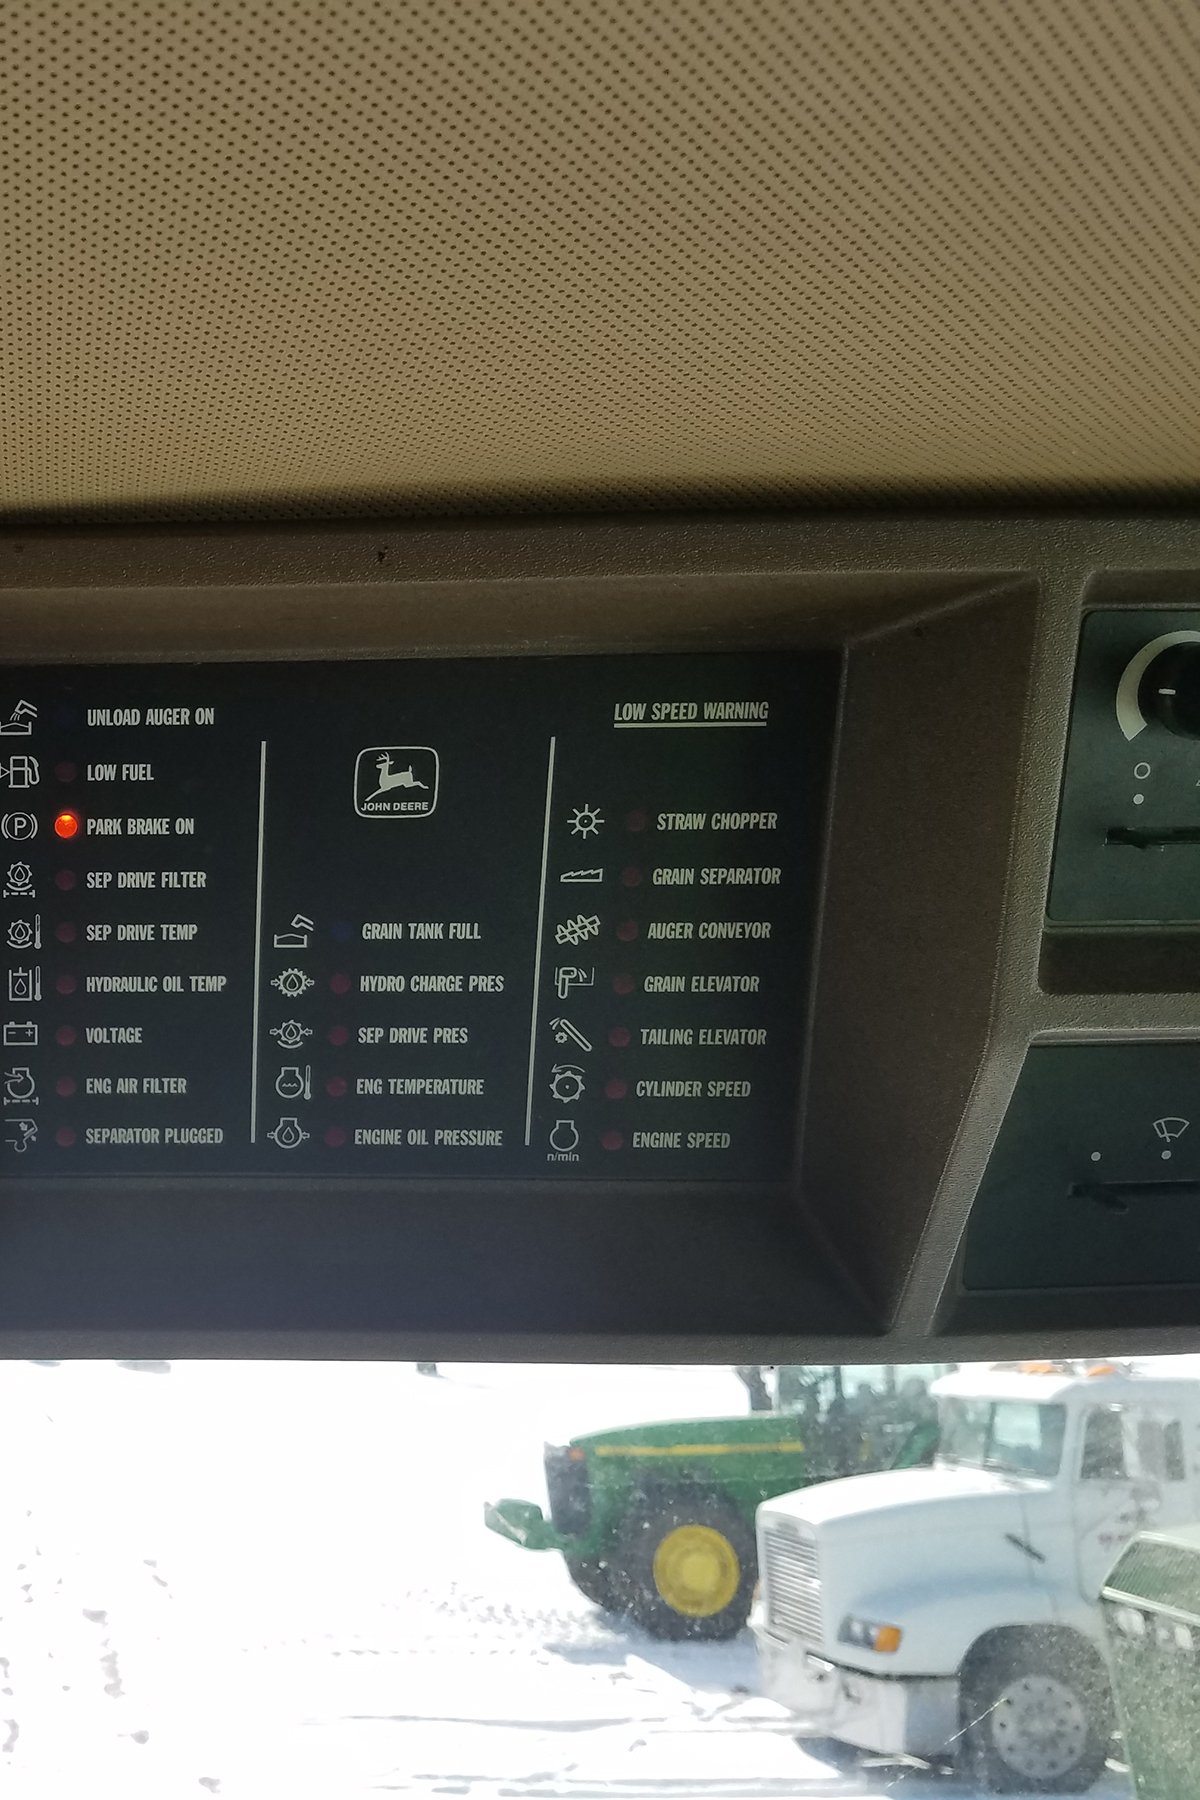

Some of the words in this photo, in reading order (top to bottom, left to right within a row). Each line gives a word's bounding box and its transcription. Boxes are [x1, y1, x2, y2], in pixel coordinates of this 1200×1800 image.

[87, 708, 141, 727] UNLOAD
[145, 707, 191, 726] AUGER
[194, 707, 215, 726] ON
[613, 703, 647, 722] LOW
[650, 702, 699, 721] SPEED
[702, 701, 770, 721] WARNING
[87, 763, 117, 782] LOW
[122, 763, 155, 781] FUEL
[360, 802, 391, 813] JOHN
[392, 801, 430, 812] DEERE
[86, 818, 122, 836] PARK
[127, 818, 171, 835] BRAKE
[175, 817, 195, 835] ON
[656, 813, 707, 831] STRAW
[711, 812, 778, 830] CHOPPER
[86, 871, 113, 889] SEP
[117, 871, 156, 889] DRIVE
[161, 871, 207, 889] FILTER
[652, 867, 695, 886] GRAIN
[699, 867, 782, 885] SEPARATOR
[86, 924, 112, 941] SEP
[117, 924, 155, 941] DRIVE
[159, 923, 198, 941] TEMP
[361, 922, 403, 940] GRAIN
[407, 922, 444, 940] TANK
[448, 922, 482, 940] FULL
[647, 922, 694, 940] AUGER
[698, 921, 772, 940] CONVEYOR
[86, 975, 158, 993] HYDRAULIC
[162, 975, 185, 993] OIL
[188, 975, 227, 992] TEMP
[359, 975, 406, 993] HYDRO
[410, 975, 464, 993] CHARGE
[468, 975, 505, 993] PRES
[643, 975, 686, 993] GRAIN
[690, 975, 760, 993] ELEVATOR
[85, 1027, 143, 1044] VOLTAGE
[357, 1026, 384, 1044] SEP
[389, 1027, 430, 1044] DRIVE
[434, 1027, 469, 1044] PRES
[640, 1028, 694, 1046] TAILING
[698, 1028, 767, 1046] ELEVATOR
[86, 1077, 112, 1095] ENG
[116, 1077, 139, 1094] AIR
[142, 1077, 187, 1094] FILTER
[356, 1078, 383, 1095] ENG
[387, 1078, 485, 1096] TEMPERATURE
[636, 1080, 703, 1097] CYLINDER
[706, 1080, 752, 1098] SPEED
[85, 1127, 159, 1145] SEPARATOR
[164, 1127, 224, 1145] PLUGGED
[354, 1128, 403, 1145] ENGINE
[407, 1128, 429, 1146] OIL
[434, 1129, 504, 1146] PRESSURE
[632, 1131, 682, 1149] ENGINE
[686, 1132, 731, 1149] SPEED
[545, 1150, 581, 1162] n/min
